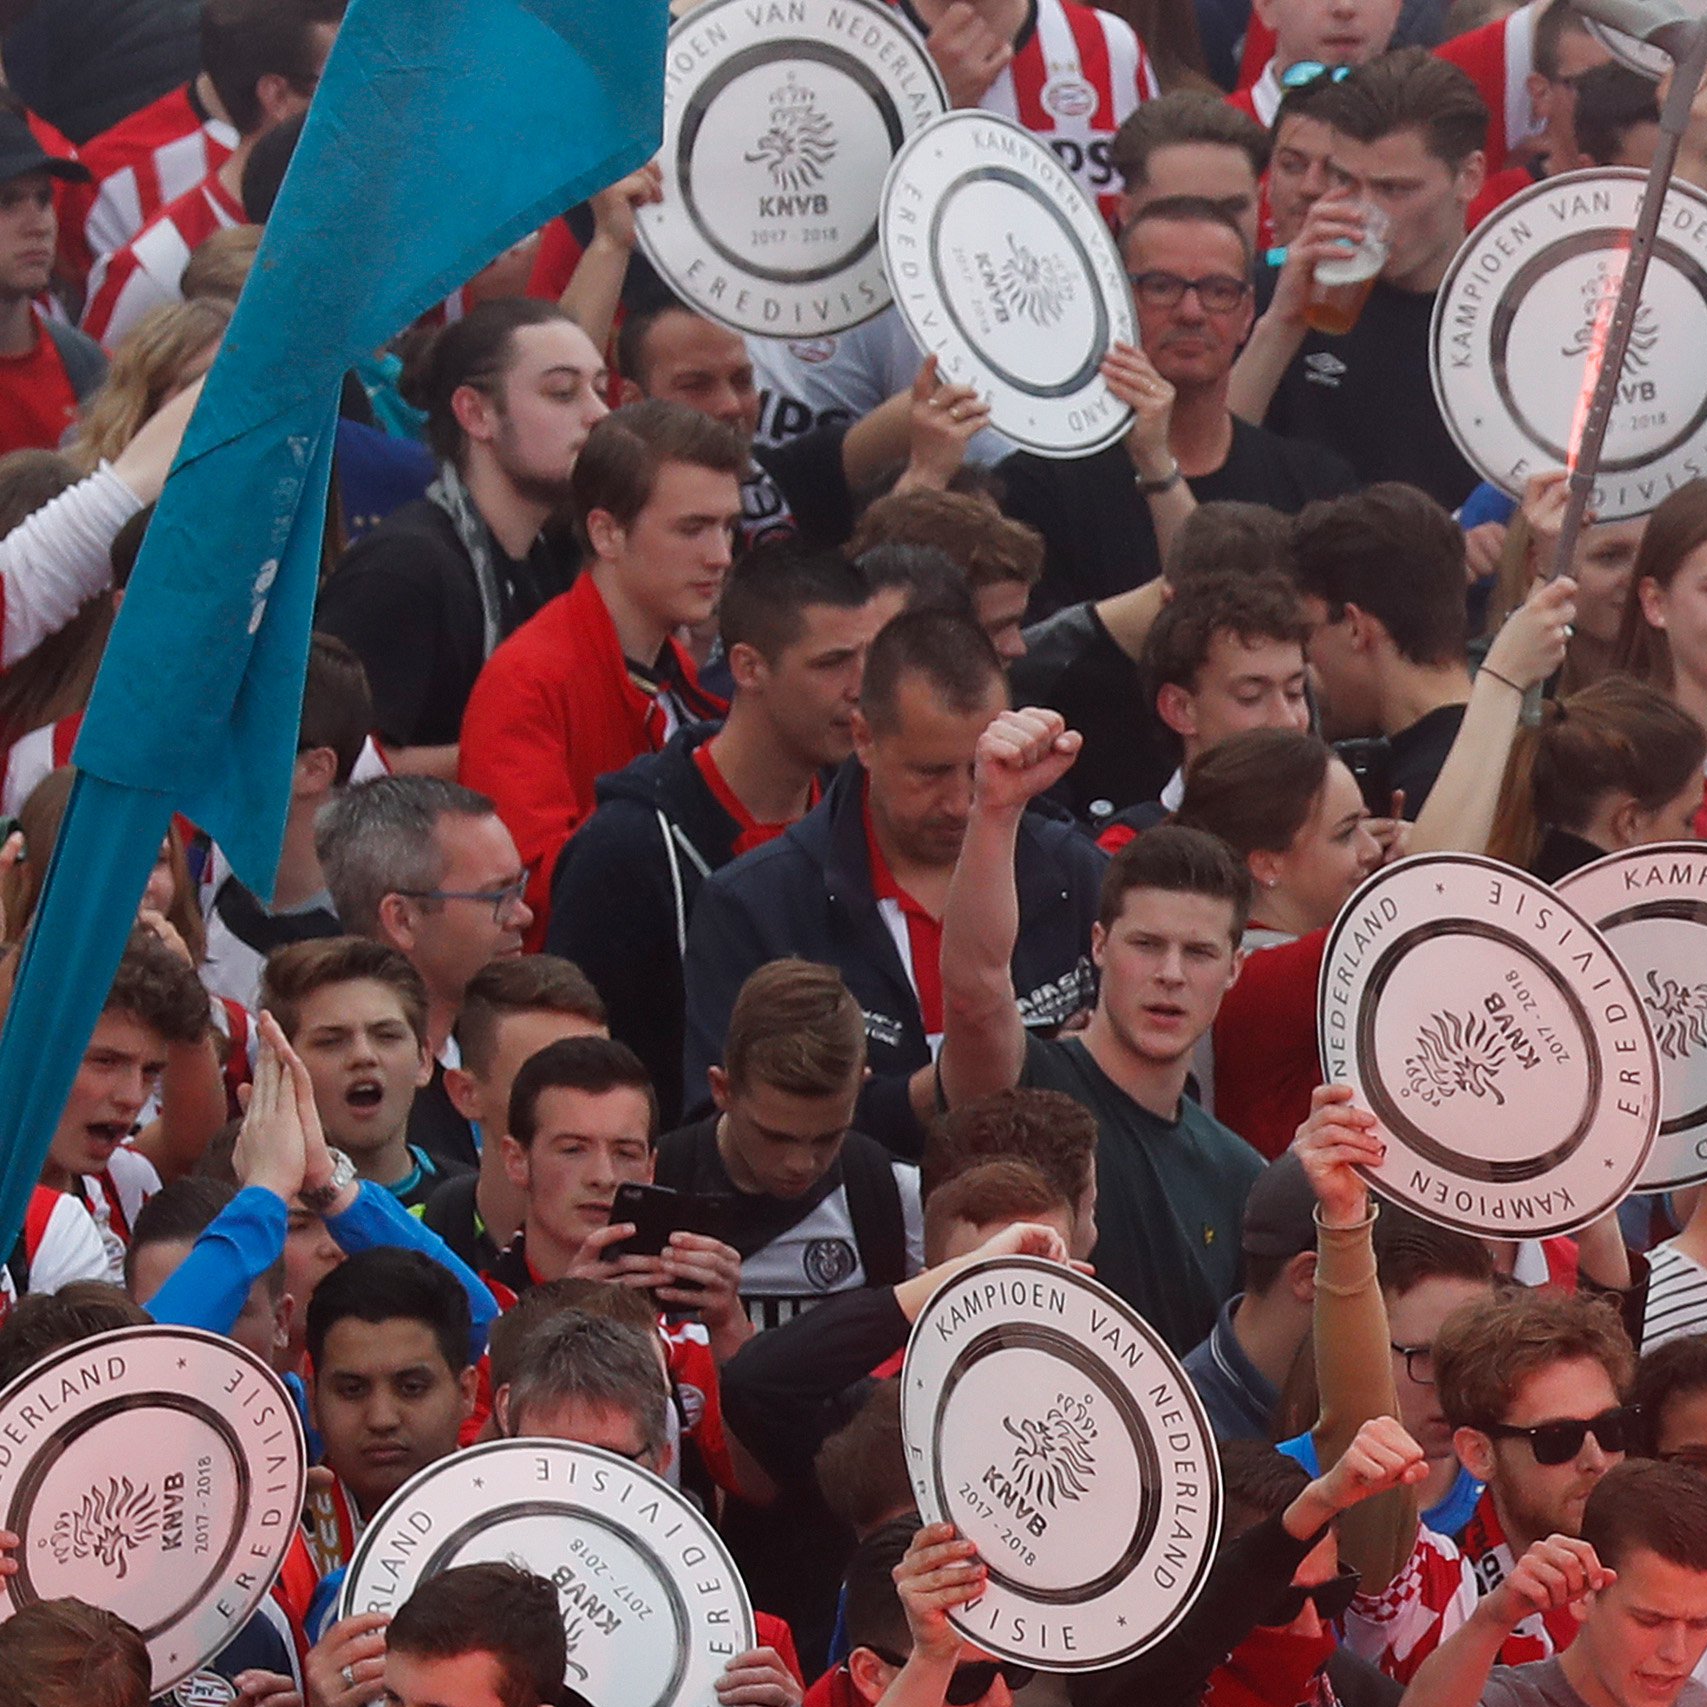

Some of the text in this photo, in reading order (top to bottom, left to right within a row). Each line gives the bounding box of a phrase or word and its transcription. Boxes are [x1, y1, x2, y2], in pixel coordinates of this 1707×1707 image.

[746, 3, 933, 128] VAN NEDERLAN
[759, 195, 828, 217] KNVB
[687, 258, 890, 323] EREDIVIS
[974, 252, 1010, 322] KNVB
[1451, 220, 1532, 368] KAMPIOEN
[1548, 191, 1610, 221] VAN
[1330, 896, 1400, 1078] NEDERLAND
[1487, 879, 1642, 1118] EREDIVISIE
[1504, 968, 1572, 1065] 2017 2018
[1482, 993, 1542, 1070] KNVB
[1410, 1169, 1576, 1221] KAMPIOEN
[934, 1280, 1198, 1591] KAMPIOEN VAN NEDERLAND
[160, 1470, 187, 1552] KNVB
[192, 1453, 213, 1555] 2017 2018
[214, 1368, 289, 1621] EREDIVISIE
[959, 1482, 1038, 1568] 2017 2018
[981, 1465, 1048, 1539] KNVB
[535, 1457, 736, 1658] EREDIVISIE
[568, 1536, 655, 1621] 2017 2018
[552, 1565, 623, 1639] KNVB
